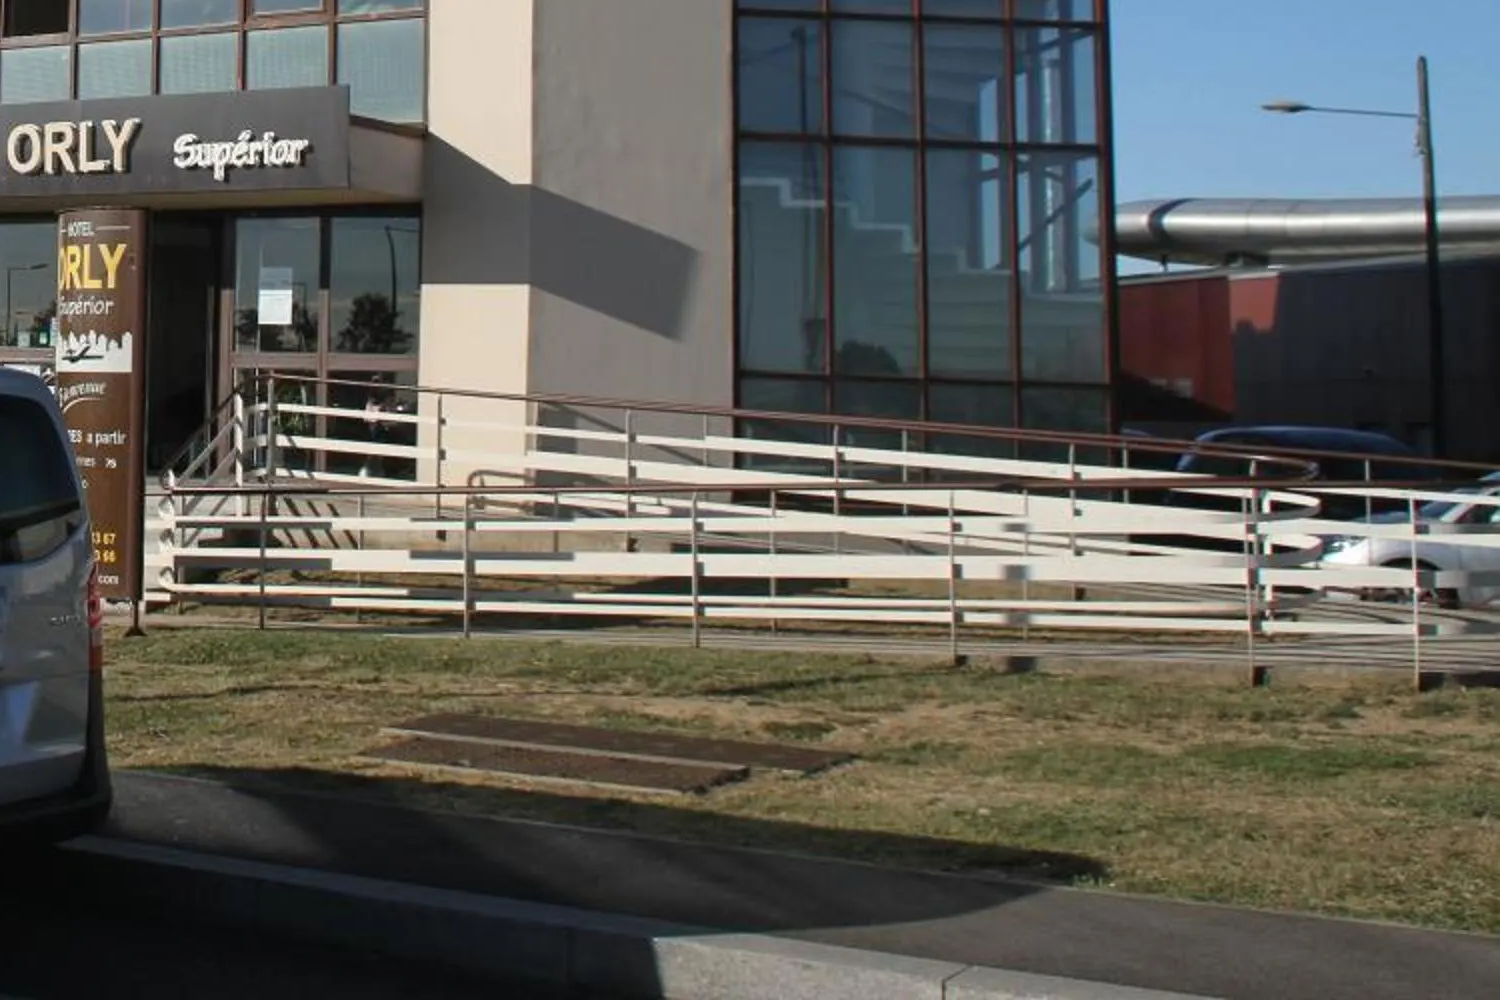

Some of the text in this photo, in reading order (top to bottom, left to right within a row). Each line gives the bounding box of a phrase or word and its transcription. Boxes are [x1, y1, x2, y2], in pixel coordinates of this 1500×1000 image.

[7, 118, 141, 174] ORLY
[173, 130, 309, 182] Supérior
[95, 429, 127, 448] partir
